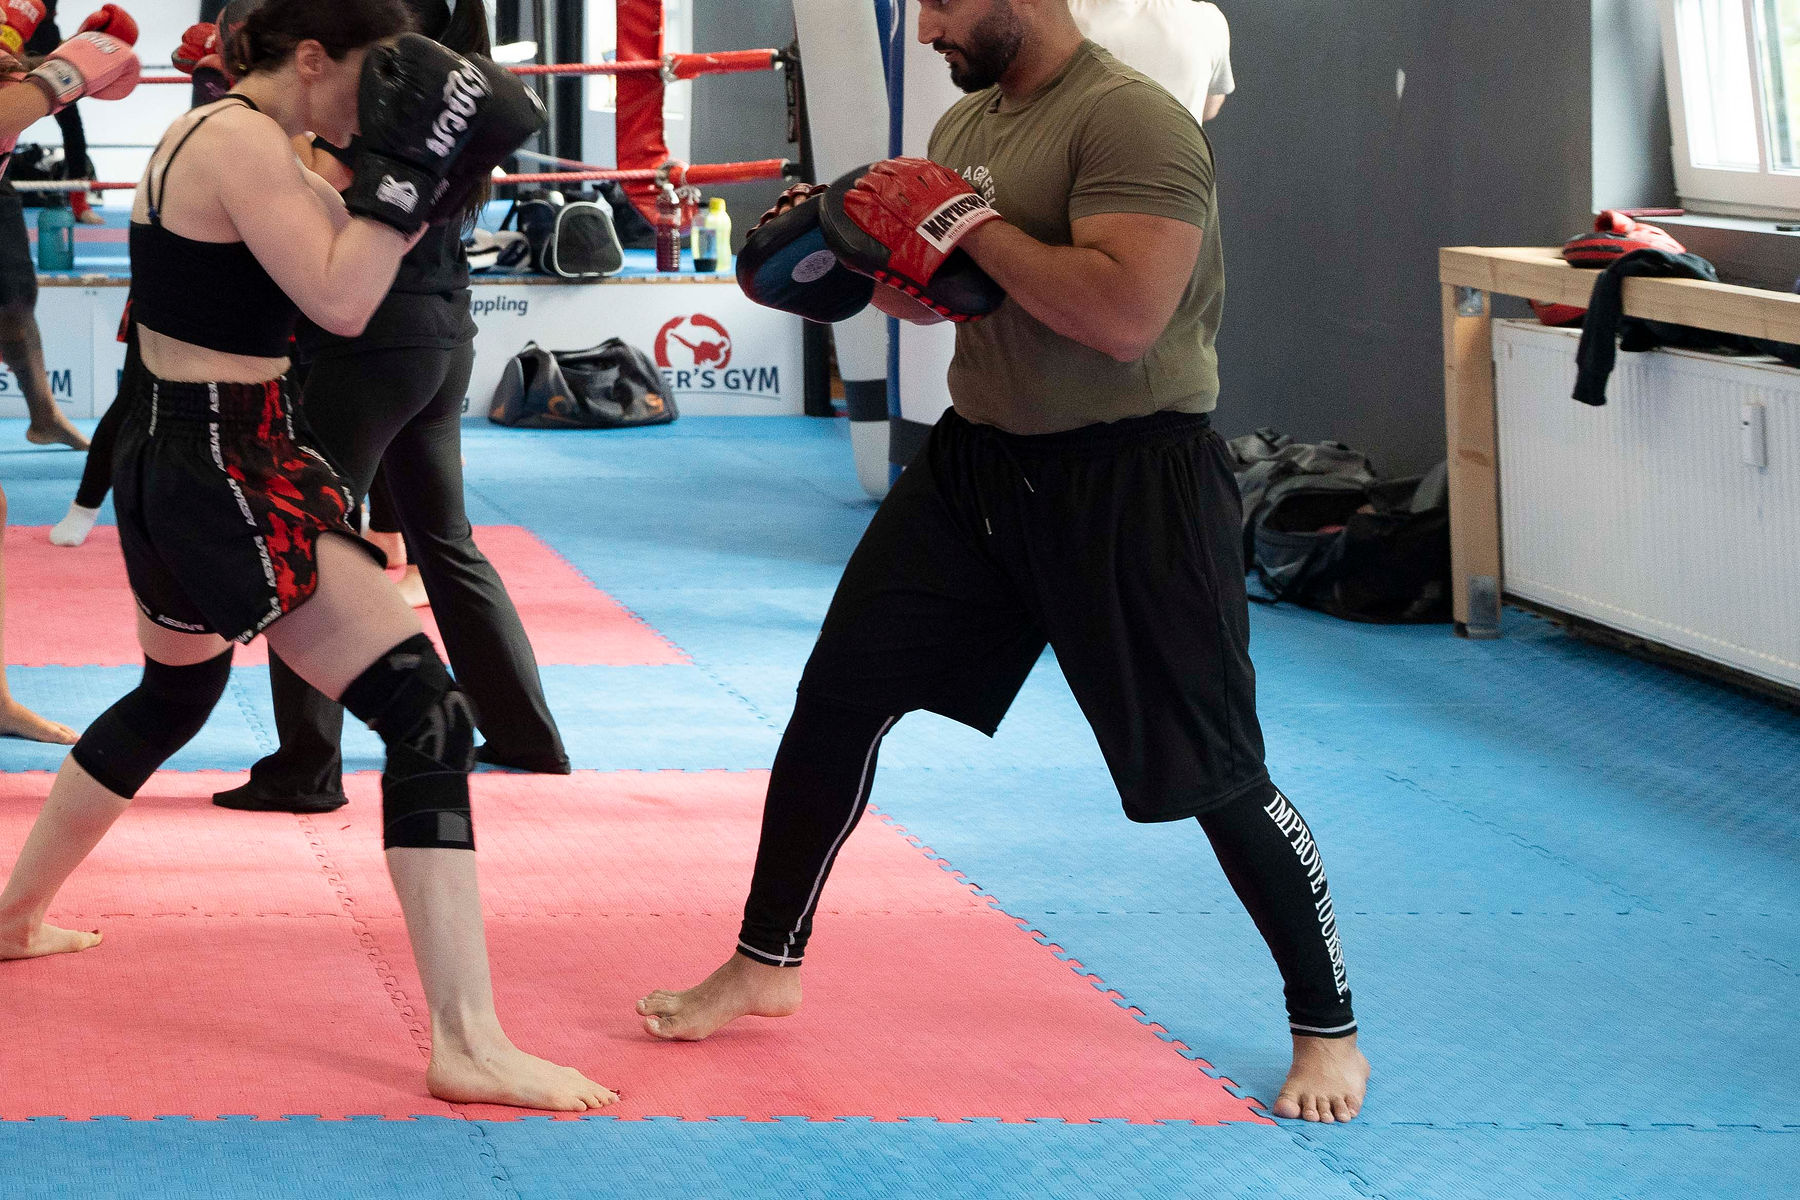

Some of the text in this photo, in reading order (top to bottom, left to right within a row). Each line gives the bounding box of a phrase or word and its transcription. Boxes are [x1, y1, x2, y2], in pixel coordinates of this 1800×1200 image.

[468, 296, 529, 316] ppling
[724, 366, 780, 394] GYM
[1263, 790, 1327, 895] IMPROVE
